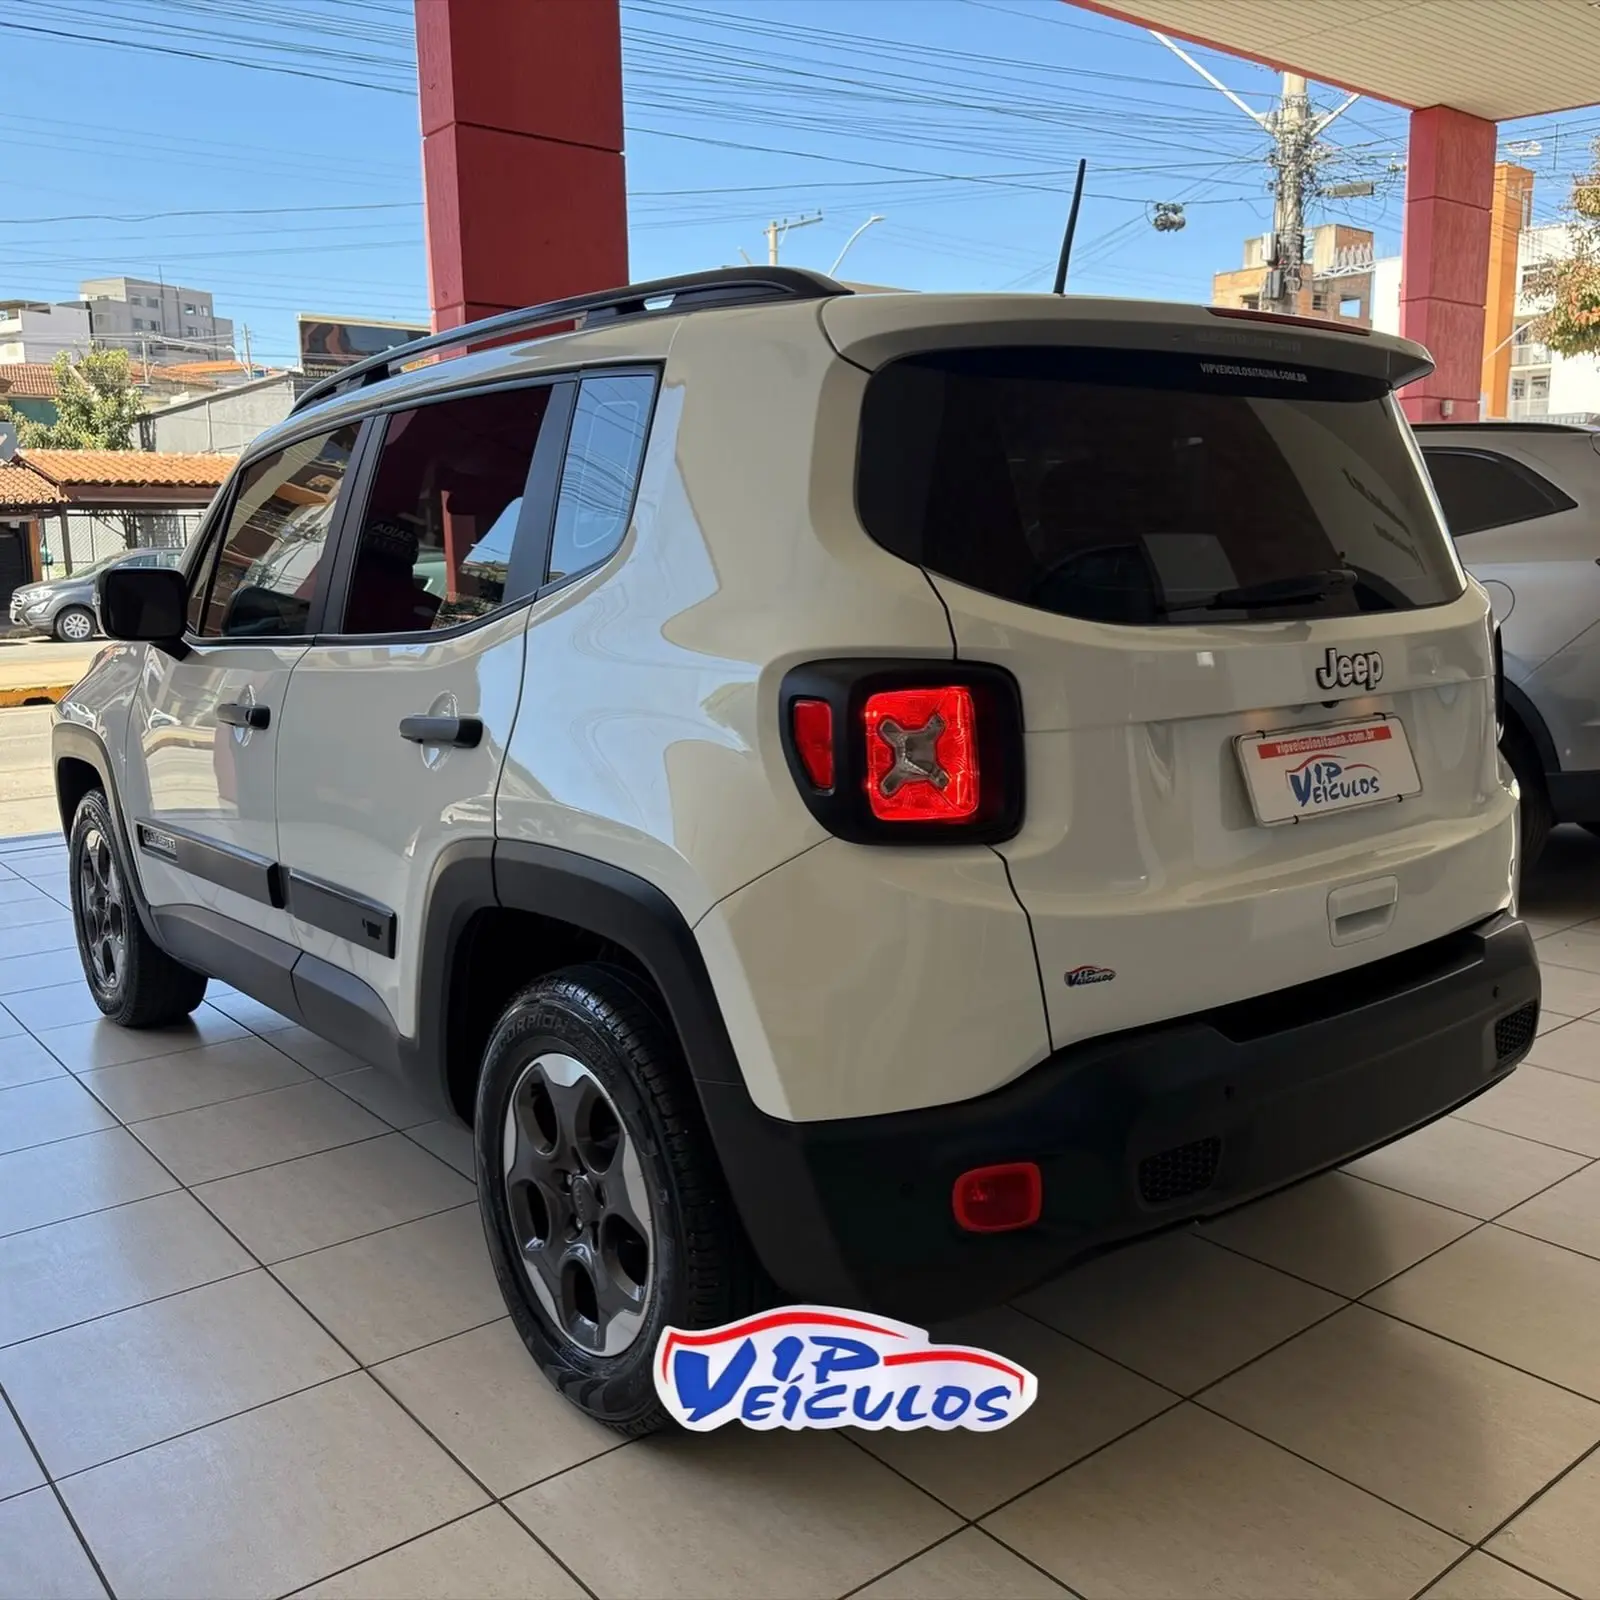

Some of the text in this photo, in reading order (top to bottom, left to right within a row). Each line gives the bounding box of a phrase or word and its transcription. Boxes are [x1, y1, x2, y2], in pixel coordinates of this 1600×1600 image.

[1316, 647, 1383, 691] Jeep
[1276, 729, 1376, 755] vipveiculositauna.com.br
[1290, 762, 1342, 807] VIP
